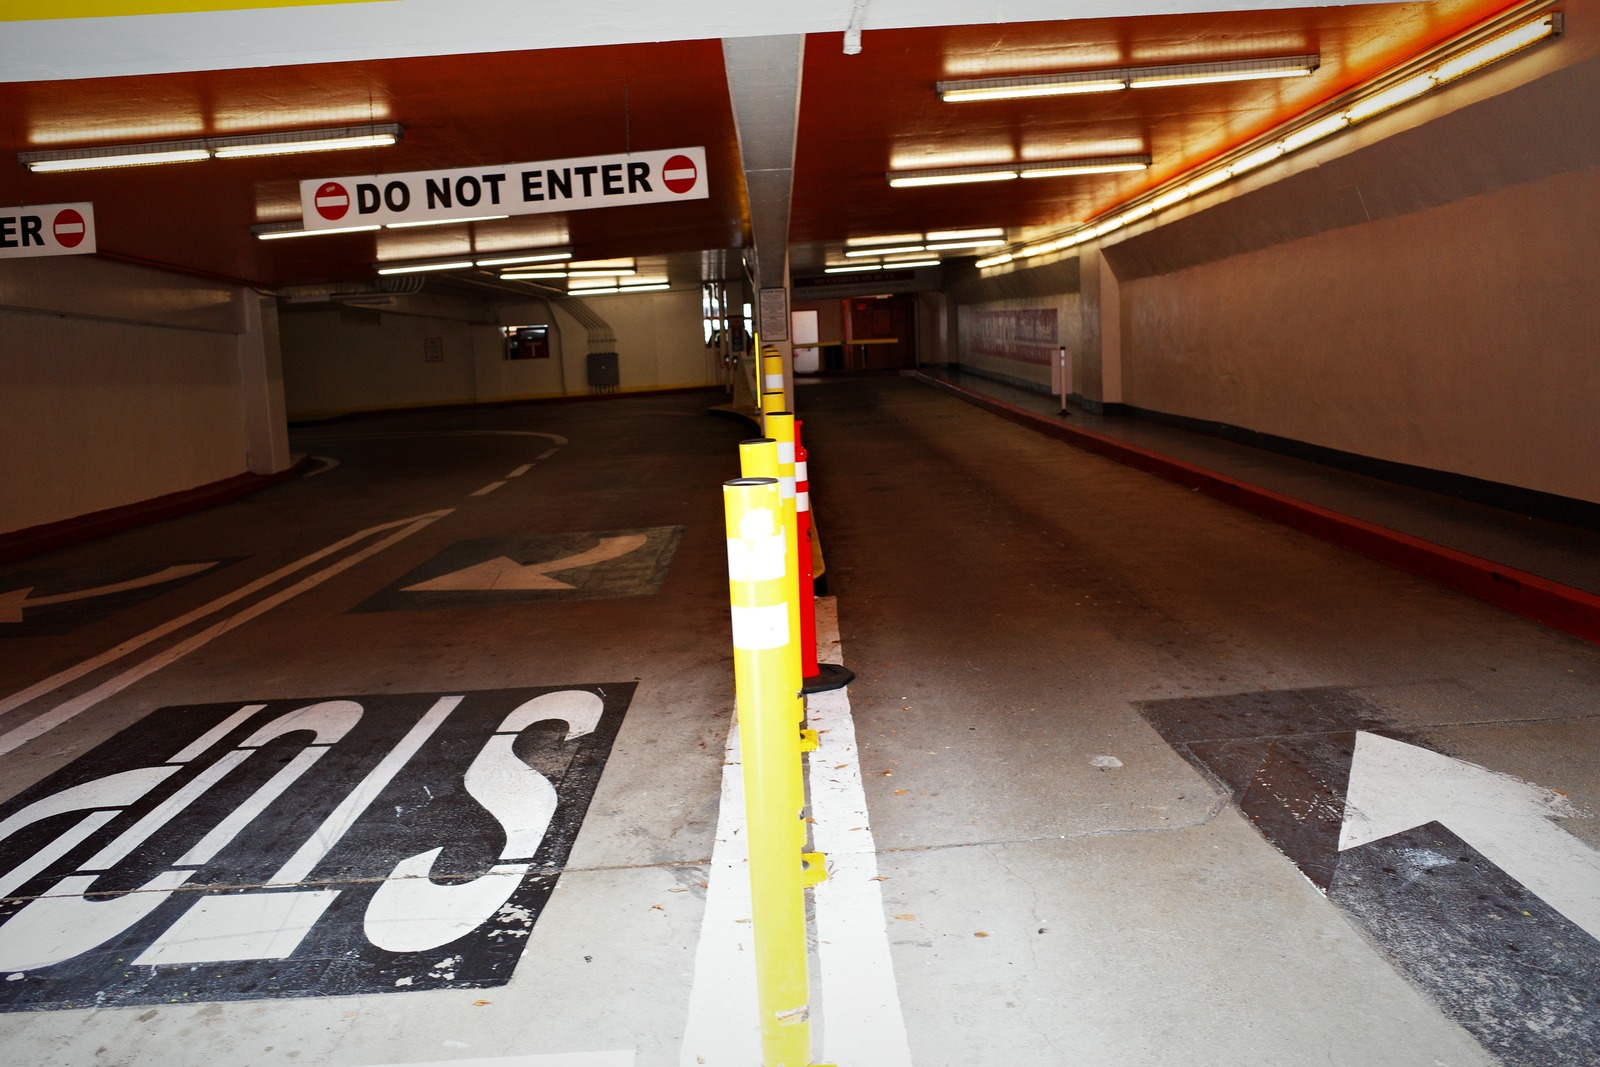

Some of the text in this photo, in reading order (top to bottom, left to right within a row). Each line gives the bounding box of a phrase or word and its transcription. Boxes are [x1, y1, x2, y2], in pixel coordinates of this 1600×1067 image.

[357, 162, 653, 215] DO NOT ENTER
